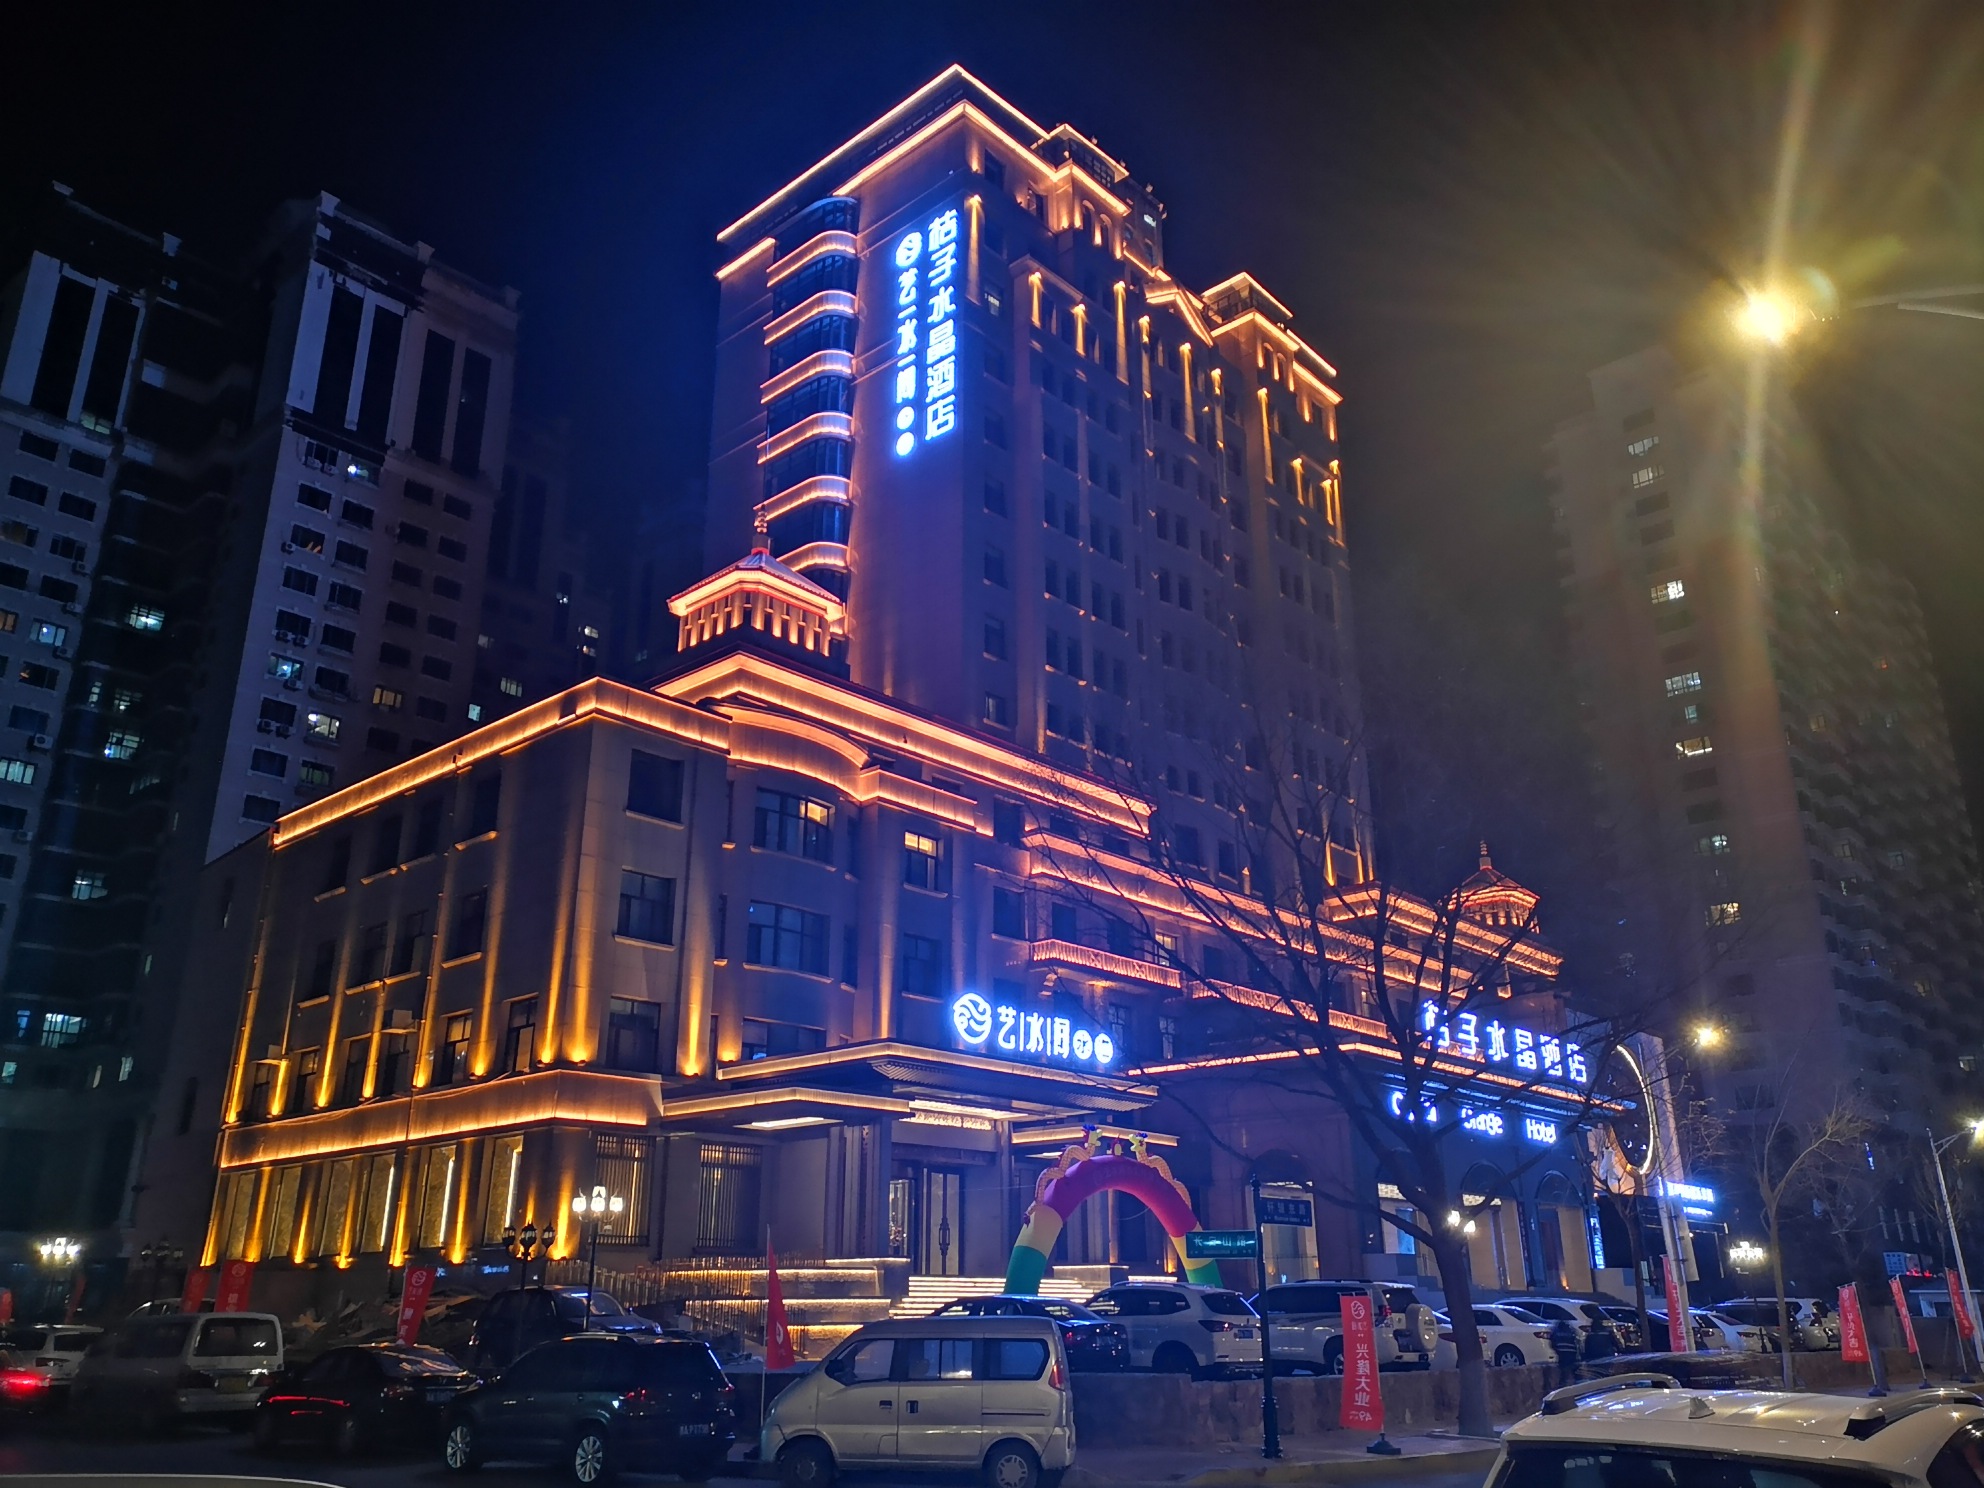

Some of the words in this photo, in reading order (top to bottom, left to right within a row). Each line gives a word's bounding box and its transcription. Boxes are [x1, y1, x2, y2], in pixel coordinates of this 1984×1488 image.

[925, 208, 958, 440] 桔子水晶酒店
[1526, 1117, 1557, 1144] Hotel
